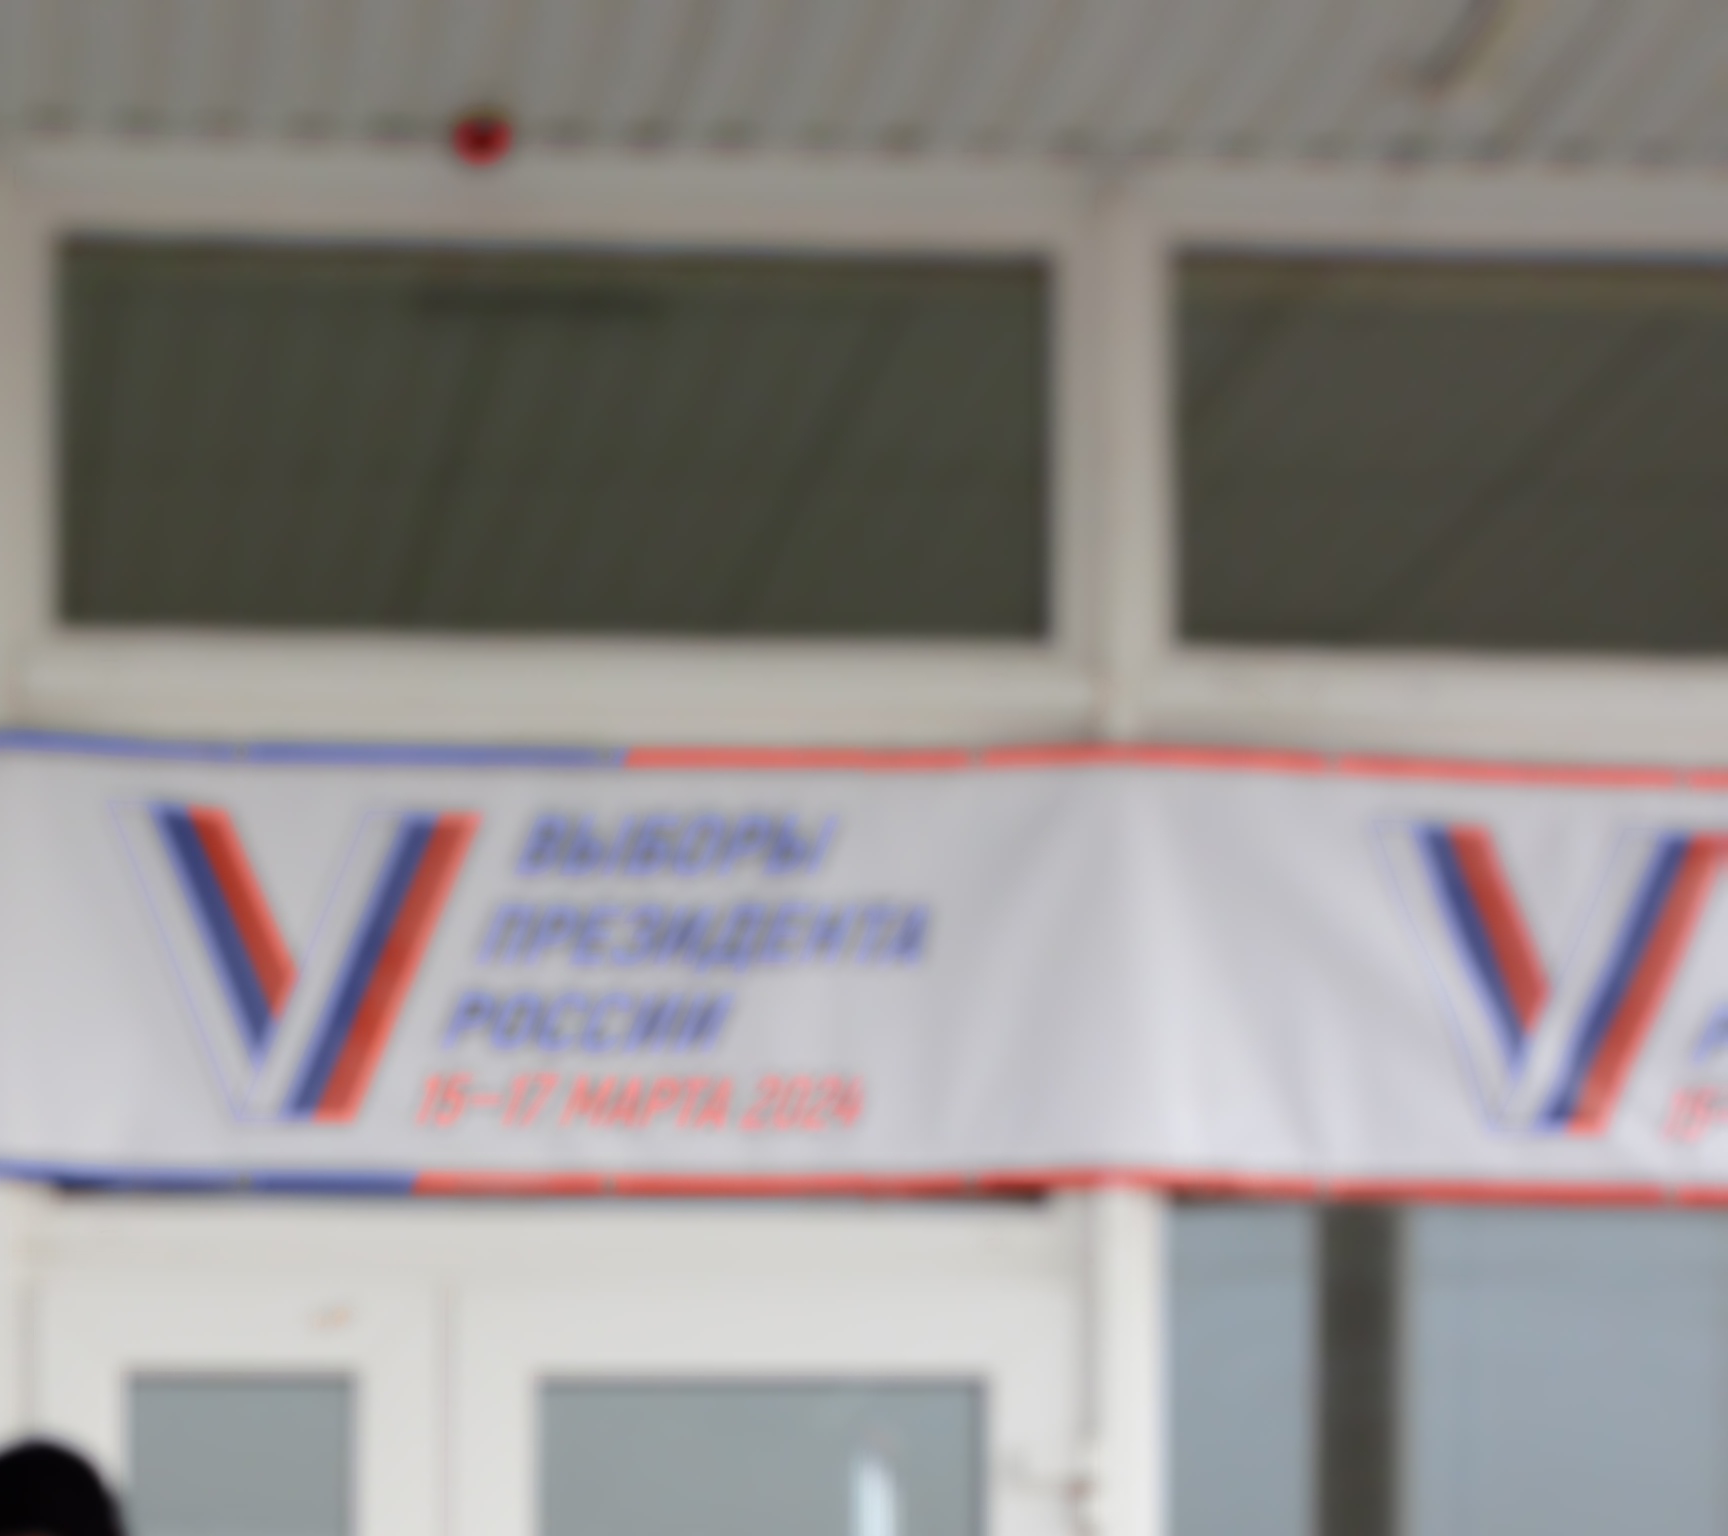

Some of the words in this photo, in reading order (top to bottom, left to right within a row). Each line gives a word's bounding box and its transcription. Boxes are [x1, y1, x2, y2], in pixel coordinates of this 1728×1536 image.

[514, 811, 838, 878] ВЫБОРЫ
[476, 900, 930, 975] ПРЕЗИДЕНТА
[442, 990, 735, 1054] РОССИИ
[558, 1073, 732, 1130] МАРТА
[740, 1074, 864, 1132] 2024
